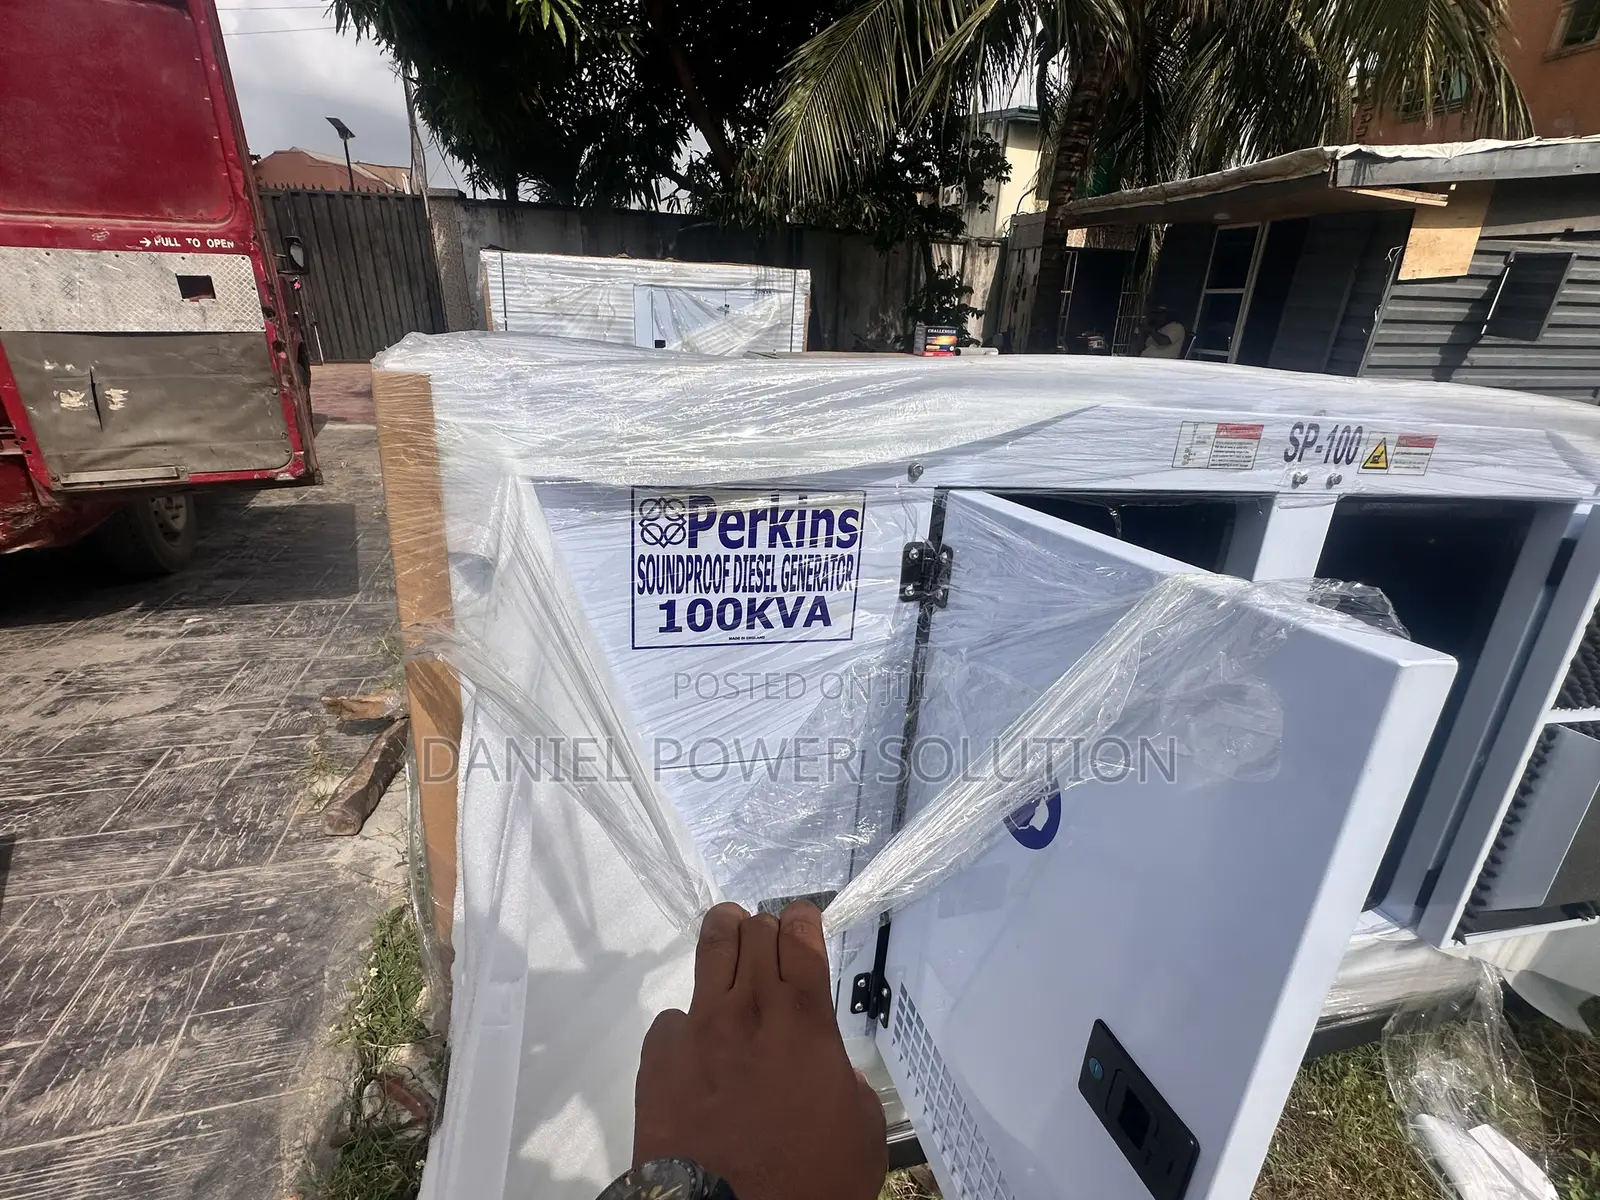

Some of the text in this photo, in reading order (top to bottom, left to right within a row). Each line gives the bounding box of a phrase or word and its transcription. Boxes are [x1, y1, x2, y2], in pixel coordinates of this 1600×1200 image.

[154, 236, 235, 249] PULL TO OPEN
[1283, 421, 1363, 465] SP-100
[688, 494, 859, 549] Perkins
[637, 553, 854, 595] SOUNDPROOF DIESEL GENERATOR
[658, 595, 832, 633] 100KVA
